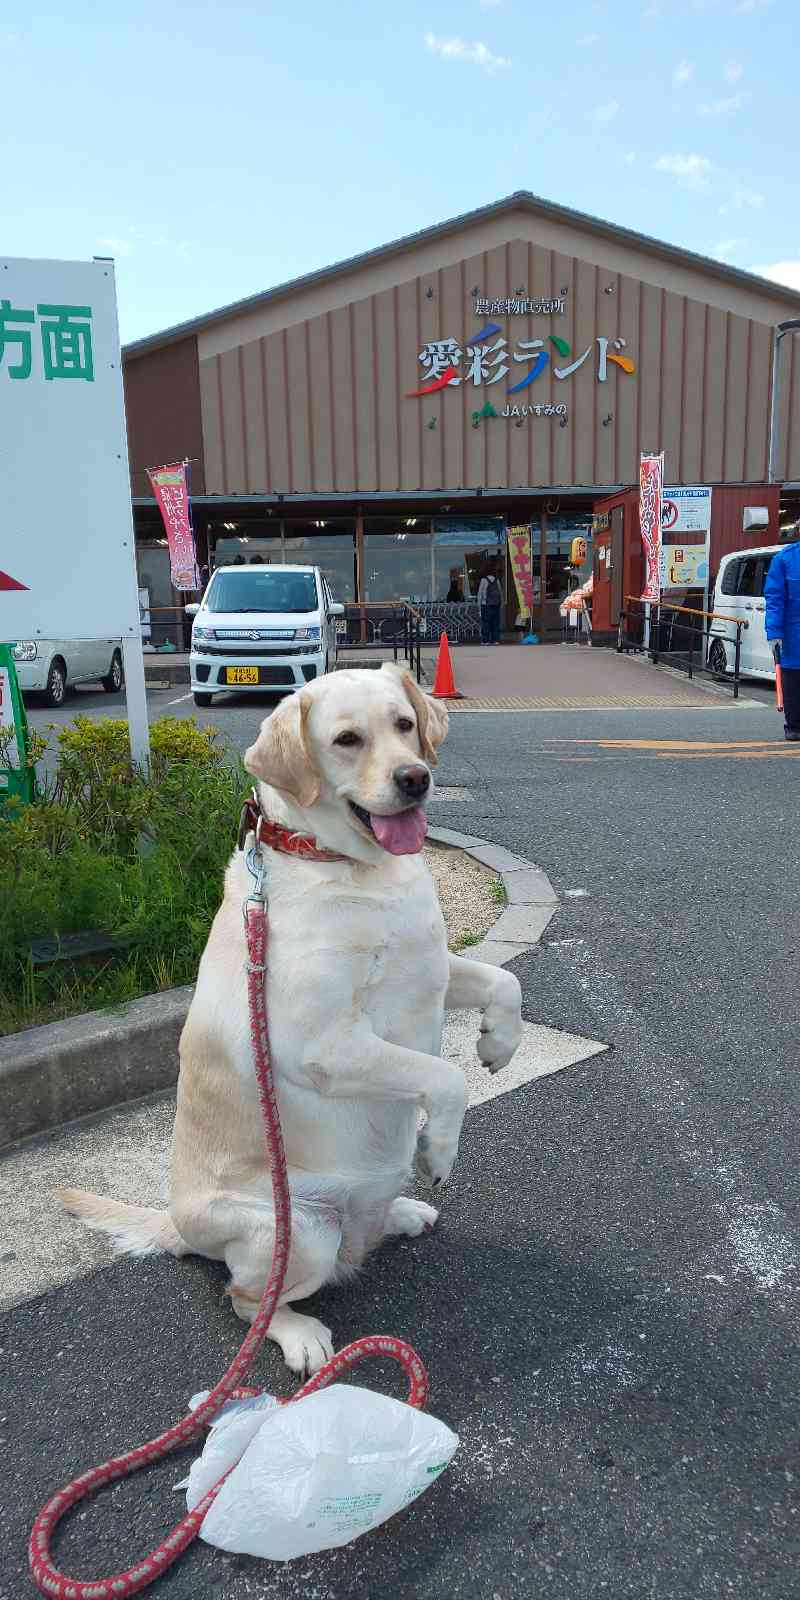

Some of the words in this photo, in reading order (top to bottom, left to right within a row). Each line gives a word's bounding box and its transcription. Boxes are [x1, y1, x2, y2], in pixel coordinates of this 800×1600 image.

[475, 298, 566, 314] 農産物直売所
[0, 300, 95, 382] 方面
[407, 322, 635, 397] 愛彩ランド
[501, 402, 567, 416] JAいずみの
